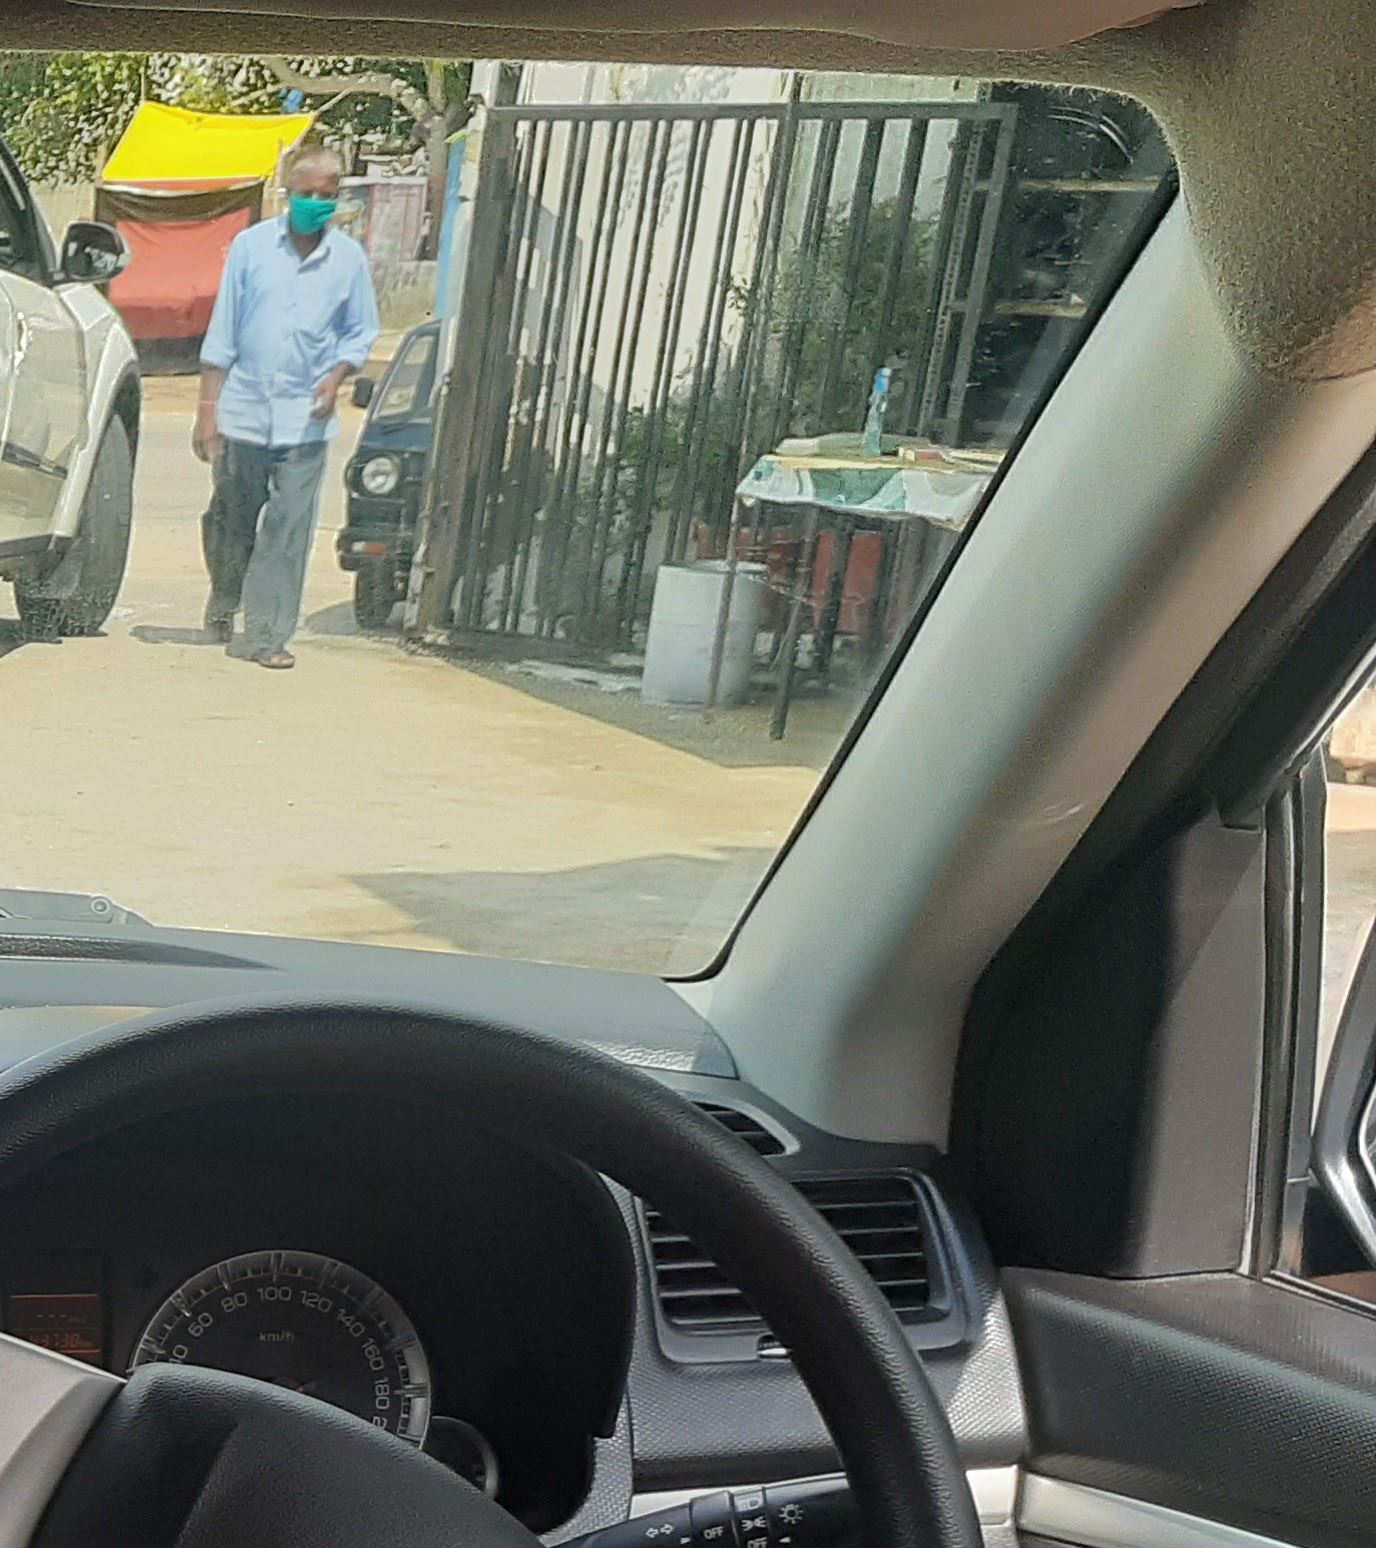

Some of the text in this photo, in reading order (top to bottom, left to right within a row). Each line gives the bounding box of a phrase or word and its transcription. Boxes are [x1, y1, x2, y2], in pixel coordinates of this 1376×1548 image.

[220, 1292, 249, 1313] 80
[256, 1286, 292, 1301] 100
[300, 1289, 333, 1313] 120
[188, 1312, 214, 1338] 60
[337, 1309, 365, 1338] 140
[259, 1330, 295, 1342] km/h
[361, 1337, 385, 1371] 160
[374, 1376, 390, 1411] 180
[704, 1526, 724, 1540] OFF
